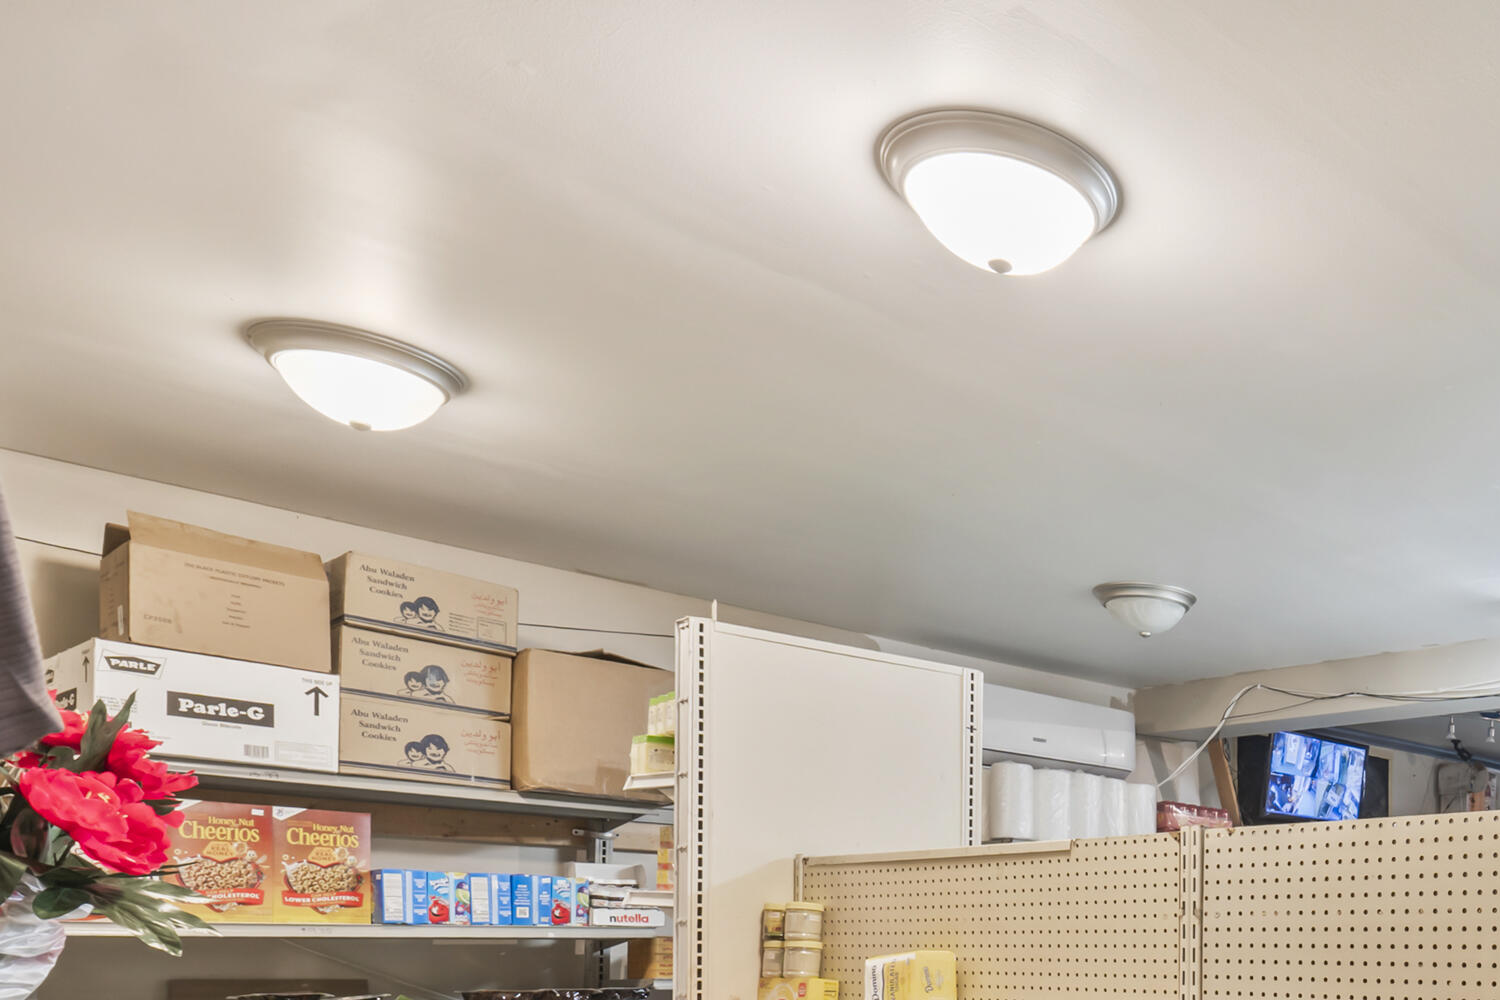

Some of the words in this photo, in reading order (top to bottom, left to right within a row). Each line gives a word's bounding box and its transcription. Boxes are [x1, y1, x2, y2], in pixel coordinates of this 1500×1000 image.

[360, 564, 377, 574] Abu
[380, 568, 415, 583] Waladen
[366, 575, 408, 590] Sandwich
[369, 586, 403, 599] Cookies
[351, 636, 370, 647] Abu
[372, 640, 409, 654] Waladen
[359, 648, 401, 662] Sandwich
[110, 658, 157, 672] PARLE
[362, 658, 397, 671] Cookies
[178, 698, 265, 721] Parle-G
[350, 708, 370, 718] Abu
[372, 711, 409, 724] Waladen
[358, 720, 401, 733] Sandwich
[361, 731, 397, 742] Cookies
[208, 816, 236, 827] Honey
[238, 817, 254, 827] Nut
[312, 823, 338, 834] Honey
[339, 825, 354, 834] Nut
[178, 820, 260, 843] Cheerios
[286, 827, 360, 848] Cheerios
[609, 913, 649, 924] nutella
